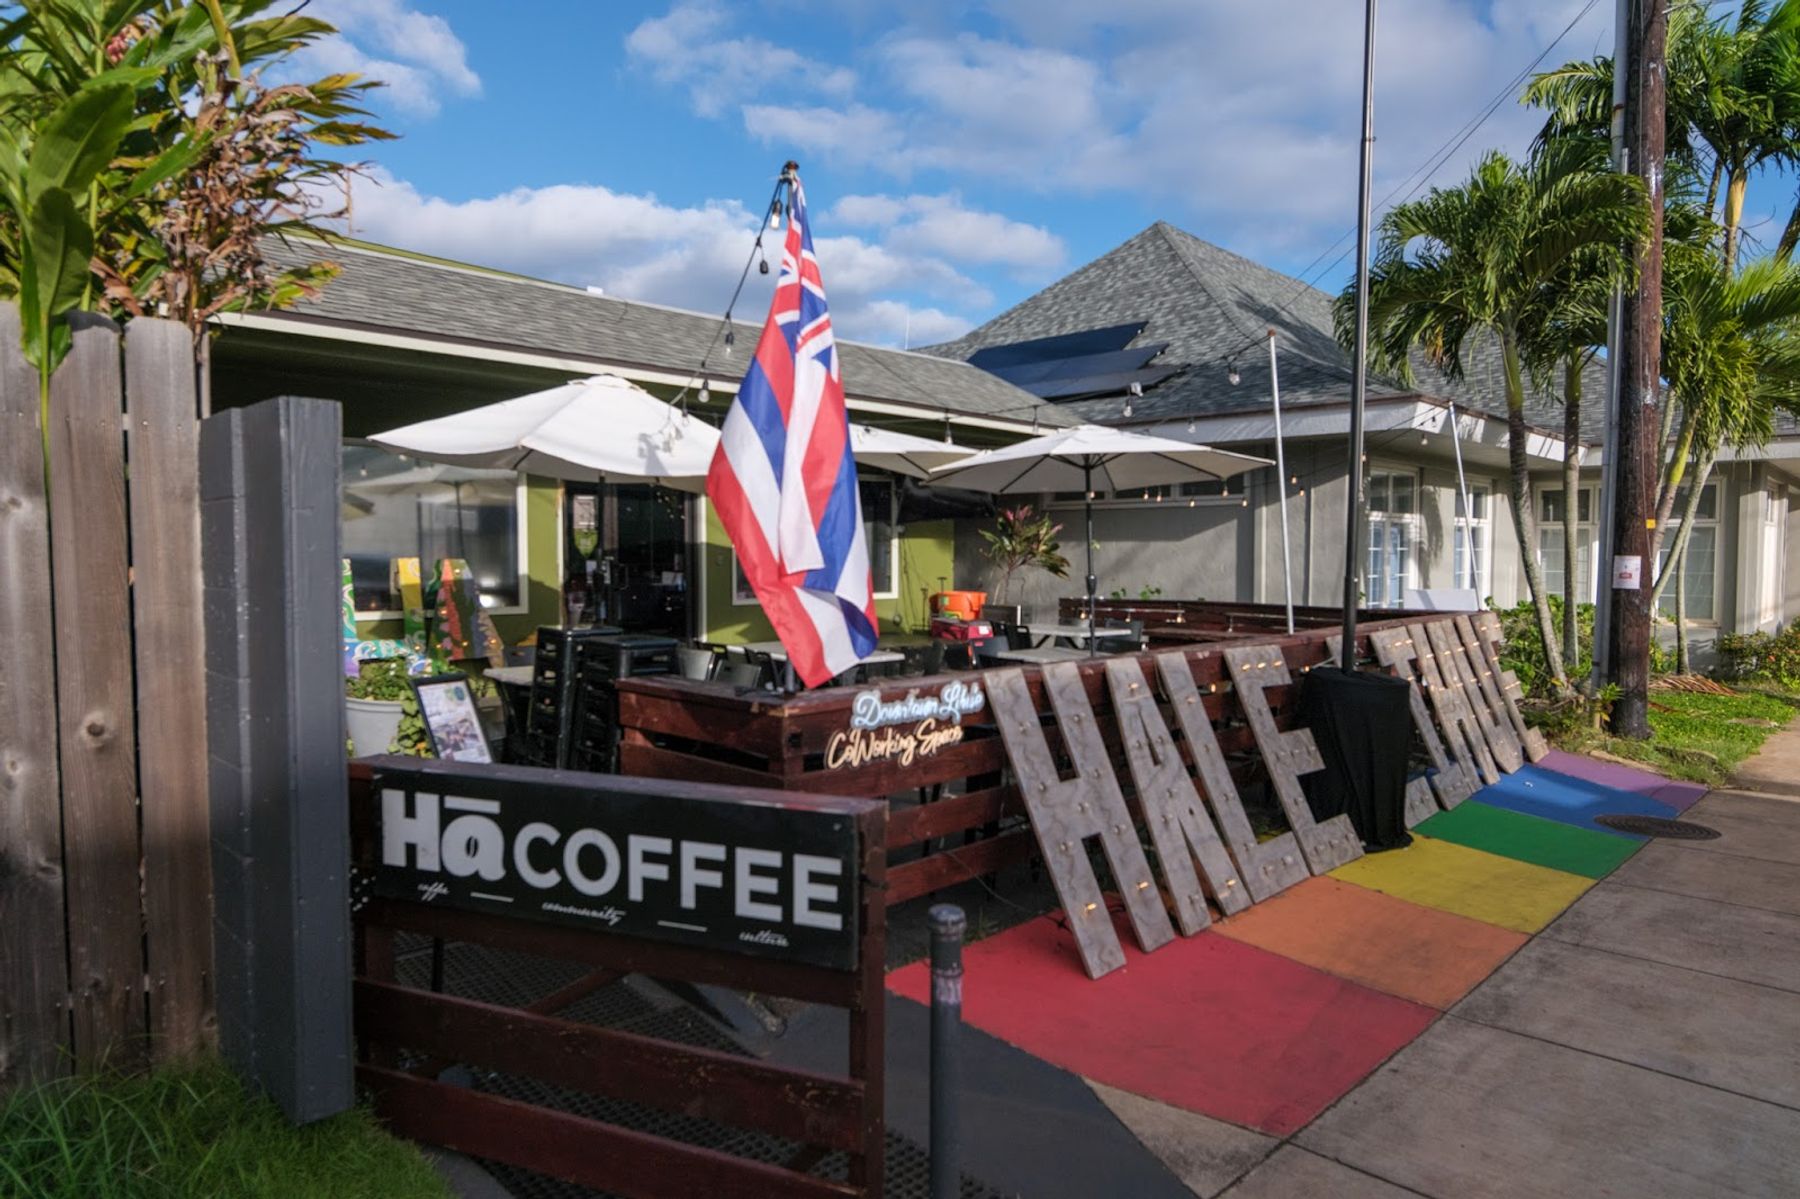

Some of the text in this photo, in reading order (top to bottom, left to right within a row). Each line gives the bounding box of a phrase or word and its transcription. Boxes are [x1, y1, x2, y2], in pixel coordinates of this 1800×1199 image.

[827, 717, 963, 769] CoWorking Space
[853, 692, 938, 726] Downtown
[984, 644, 1365, 981] HALE
[512, 820, 843, 932] COFFEE
